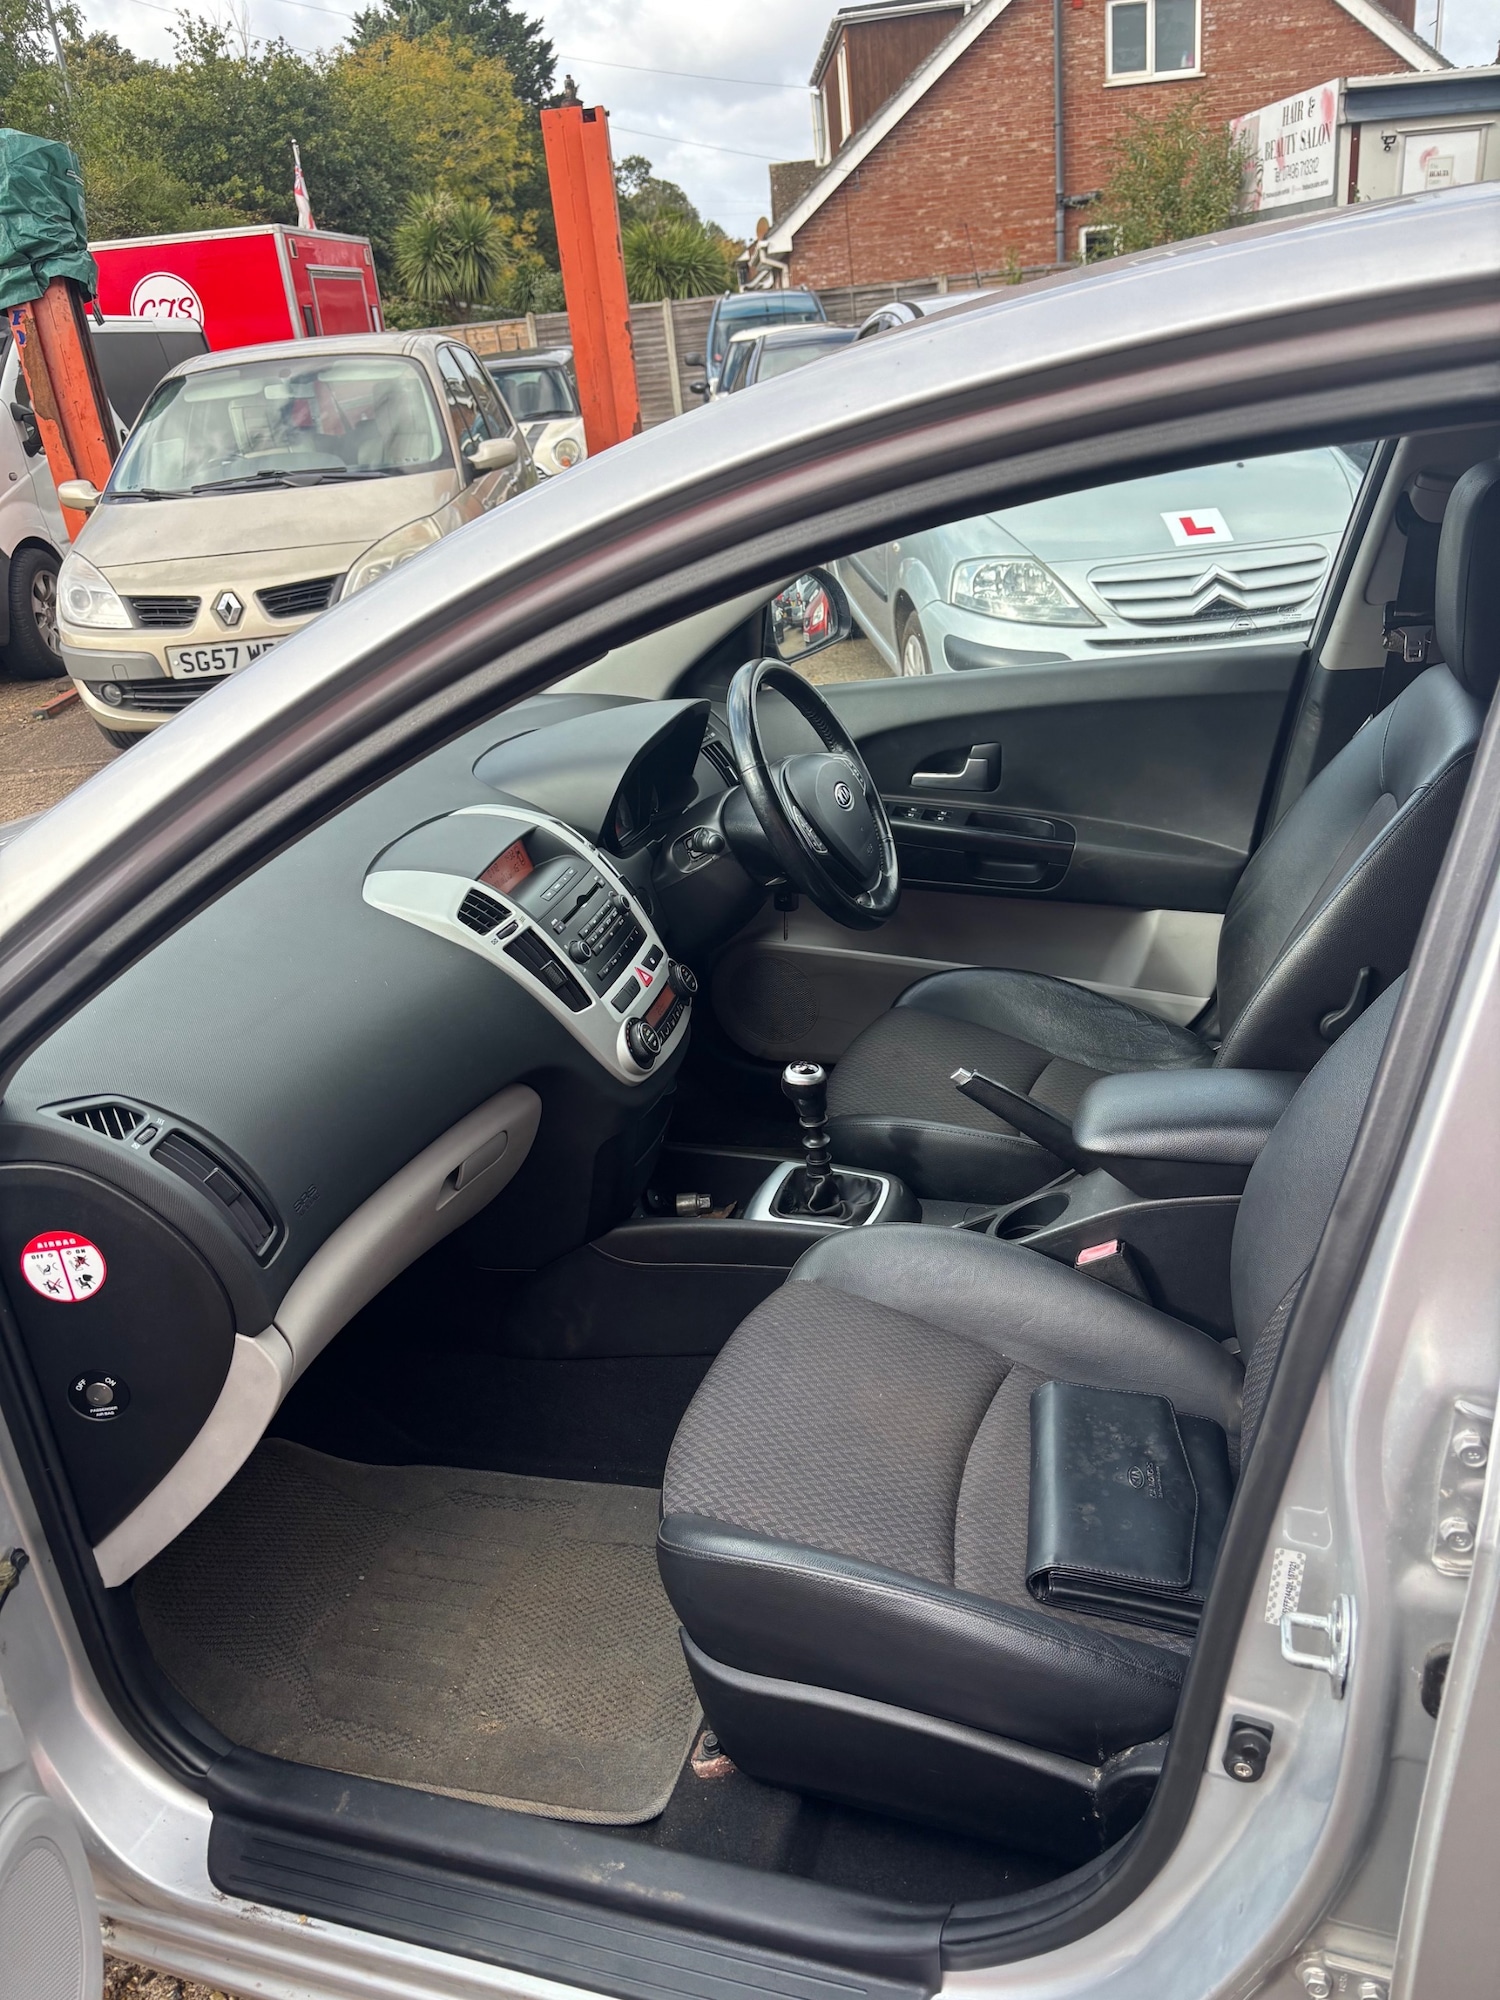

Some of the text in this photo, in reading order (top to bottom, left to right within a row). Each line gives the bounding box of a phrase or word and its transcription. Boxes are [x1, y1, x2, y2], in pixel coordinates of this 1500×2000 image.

[1282, 95, 1316, 127] HAIR &
[1265, 121, 1332, 161] BEAUTY SALON
[1179, 516, 1216, 536] L
[179, 646, 239, 674] SG57
[37, 1238, 77, 1250] AIRBAG
[75, 1379, 86, 1391] OFF
[104, 1377, 117, 1387] ON
